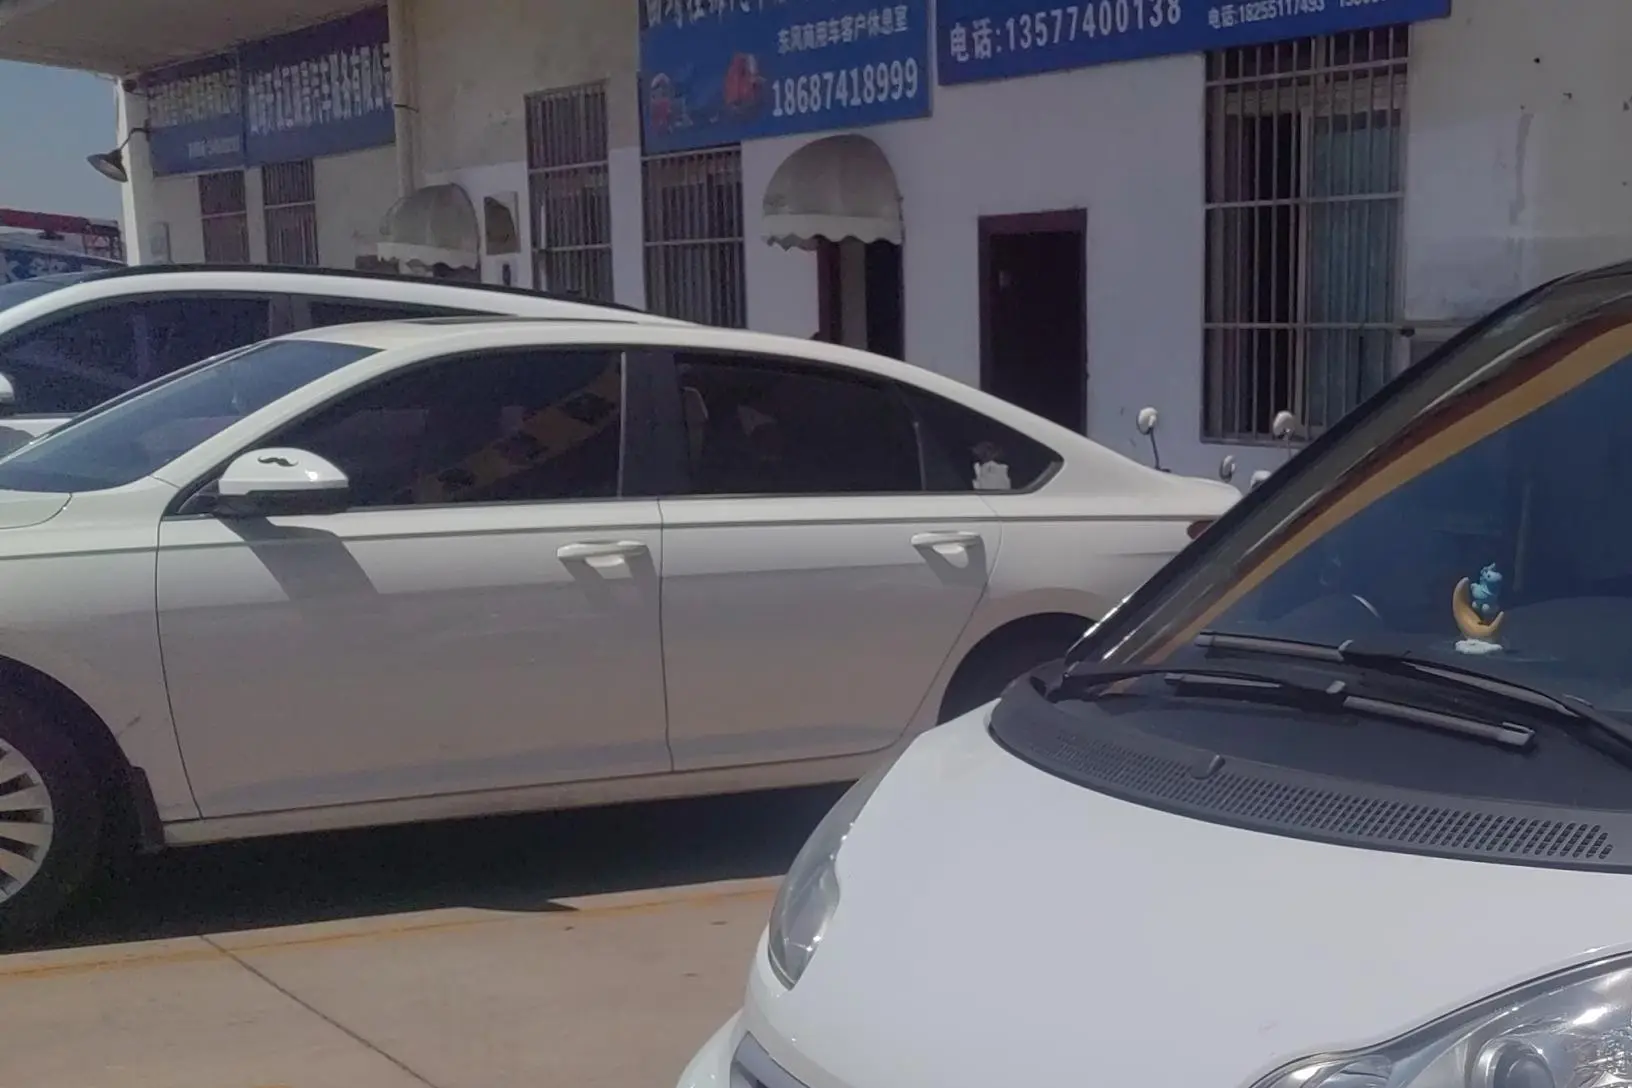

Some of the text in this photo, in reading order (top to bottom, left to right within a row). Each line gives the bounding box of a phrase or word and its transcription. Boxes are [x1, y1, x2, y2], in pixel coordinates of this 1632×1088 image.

[777, 5, 909, 54] 东风商用车客户休息室
[950, 0, 1181, 62] 电话:13577400138
[772, 57, 918, 117] 18687418999
